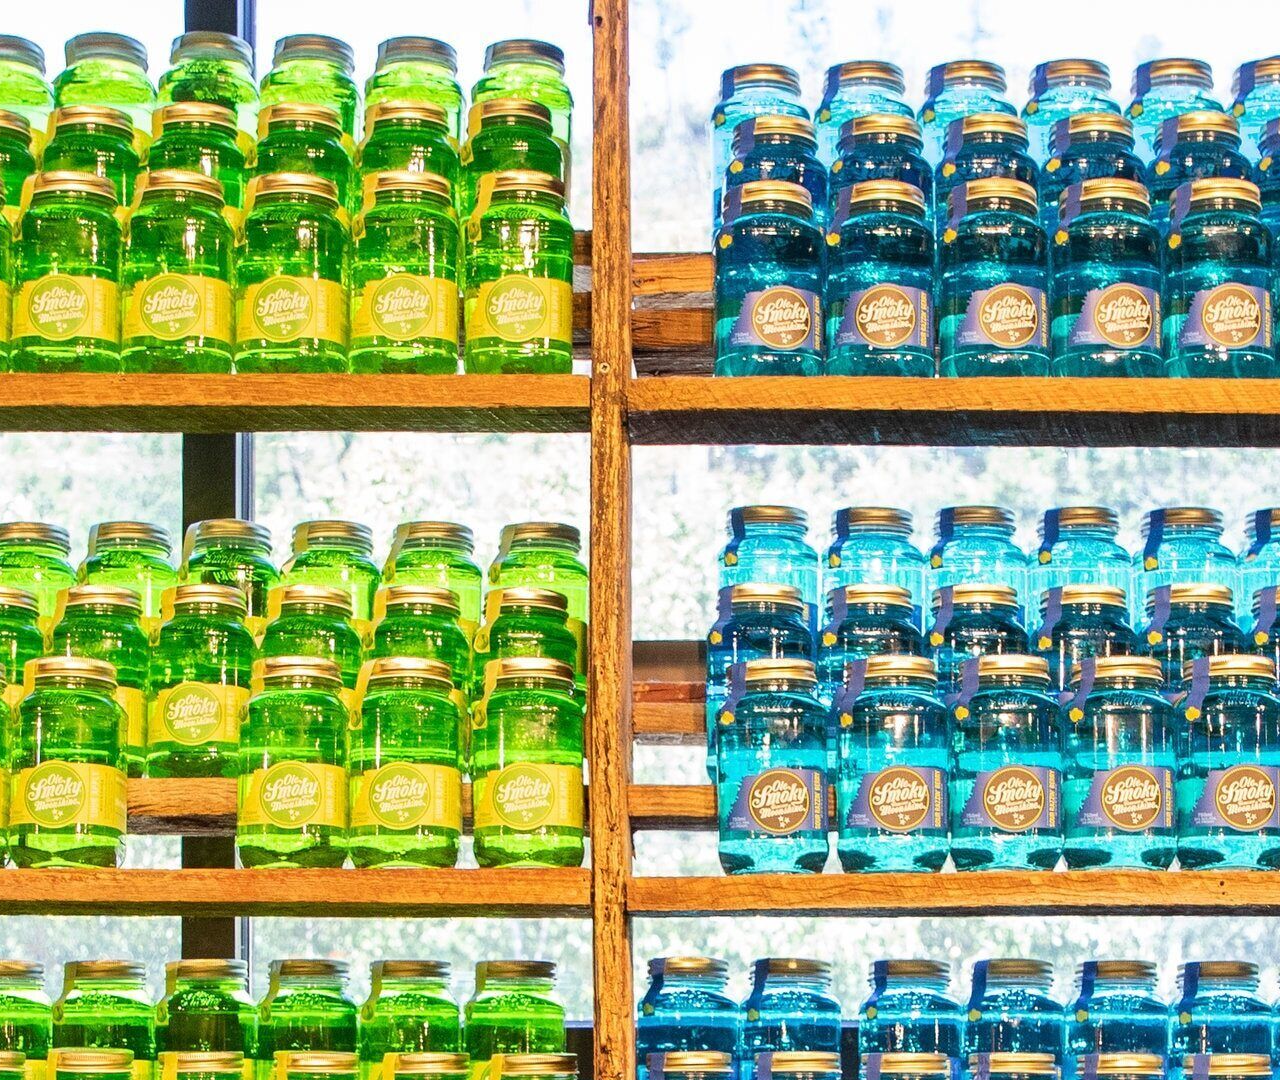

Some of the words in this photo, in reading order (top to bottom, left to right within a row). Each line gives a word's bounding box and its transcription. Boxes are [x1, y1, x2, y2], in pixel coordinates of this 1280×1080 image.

[377, 290, 430, 313] Smoky
[859, 299, 914, 323] Smoky
[373, 778, 429, 801] Smoky
[752, 783, 807, 809] Smoky
